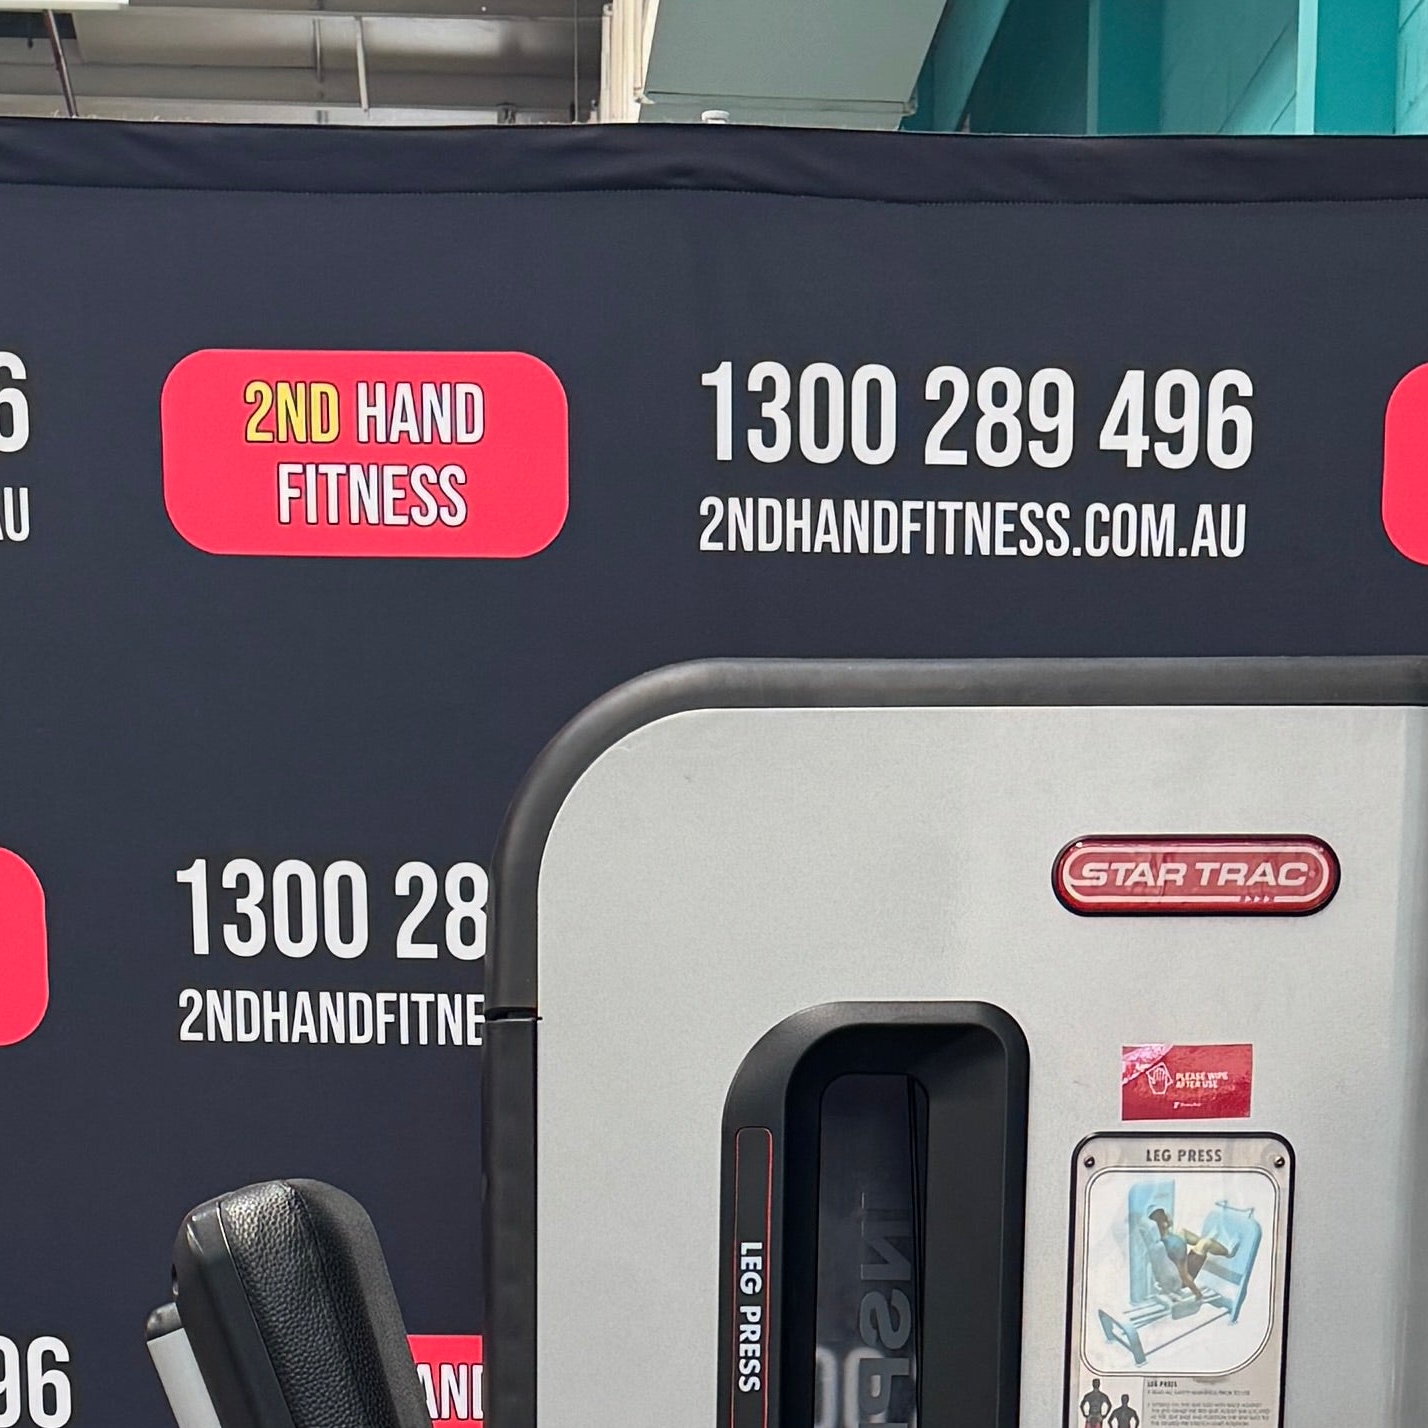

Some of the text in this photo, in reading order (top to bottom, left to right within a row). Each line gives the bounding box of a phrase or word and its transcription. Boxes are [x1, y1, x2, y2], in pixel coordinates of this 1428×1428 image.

[245, 381, 484, 443] 2ND HAND
[701, 360, 1254, 470] 1300 289 496
[278, 463, 467, 526] FITNESS
[699, 495, 1247, 558] 2NDHANDFITNESS.COM.AU
[1081, 862, 1310, 887] STAR TRAC
[176, 858, 489, 961] 1300 28
[178, 988, 486, 1046] 2NDHANDFITNE
[1146, 1148, 1222, 1162] LEG PRESS
[737, 1241, 763, 1393] LEG PRESS
